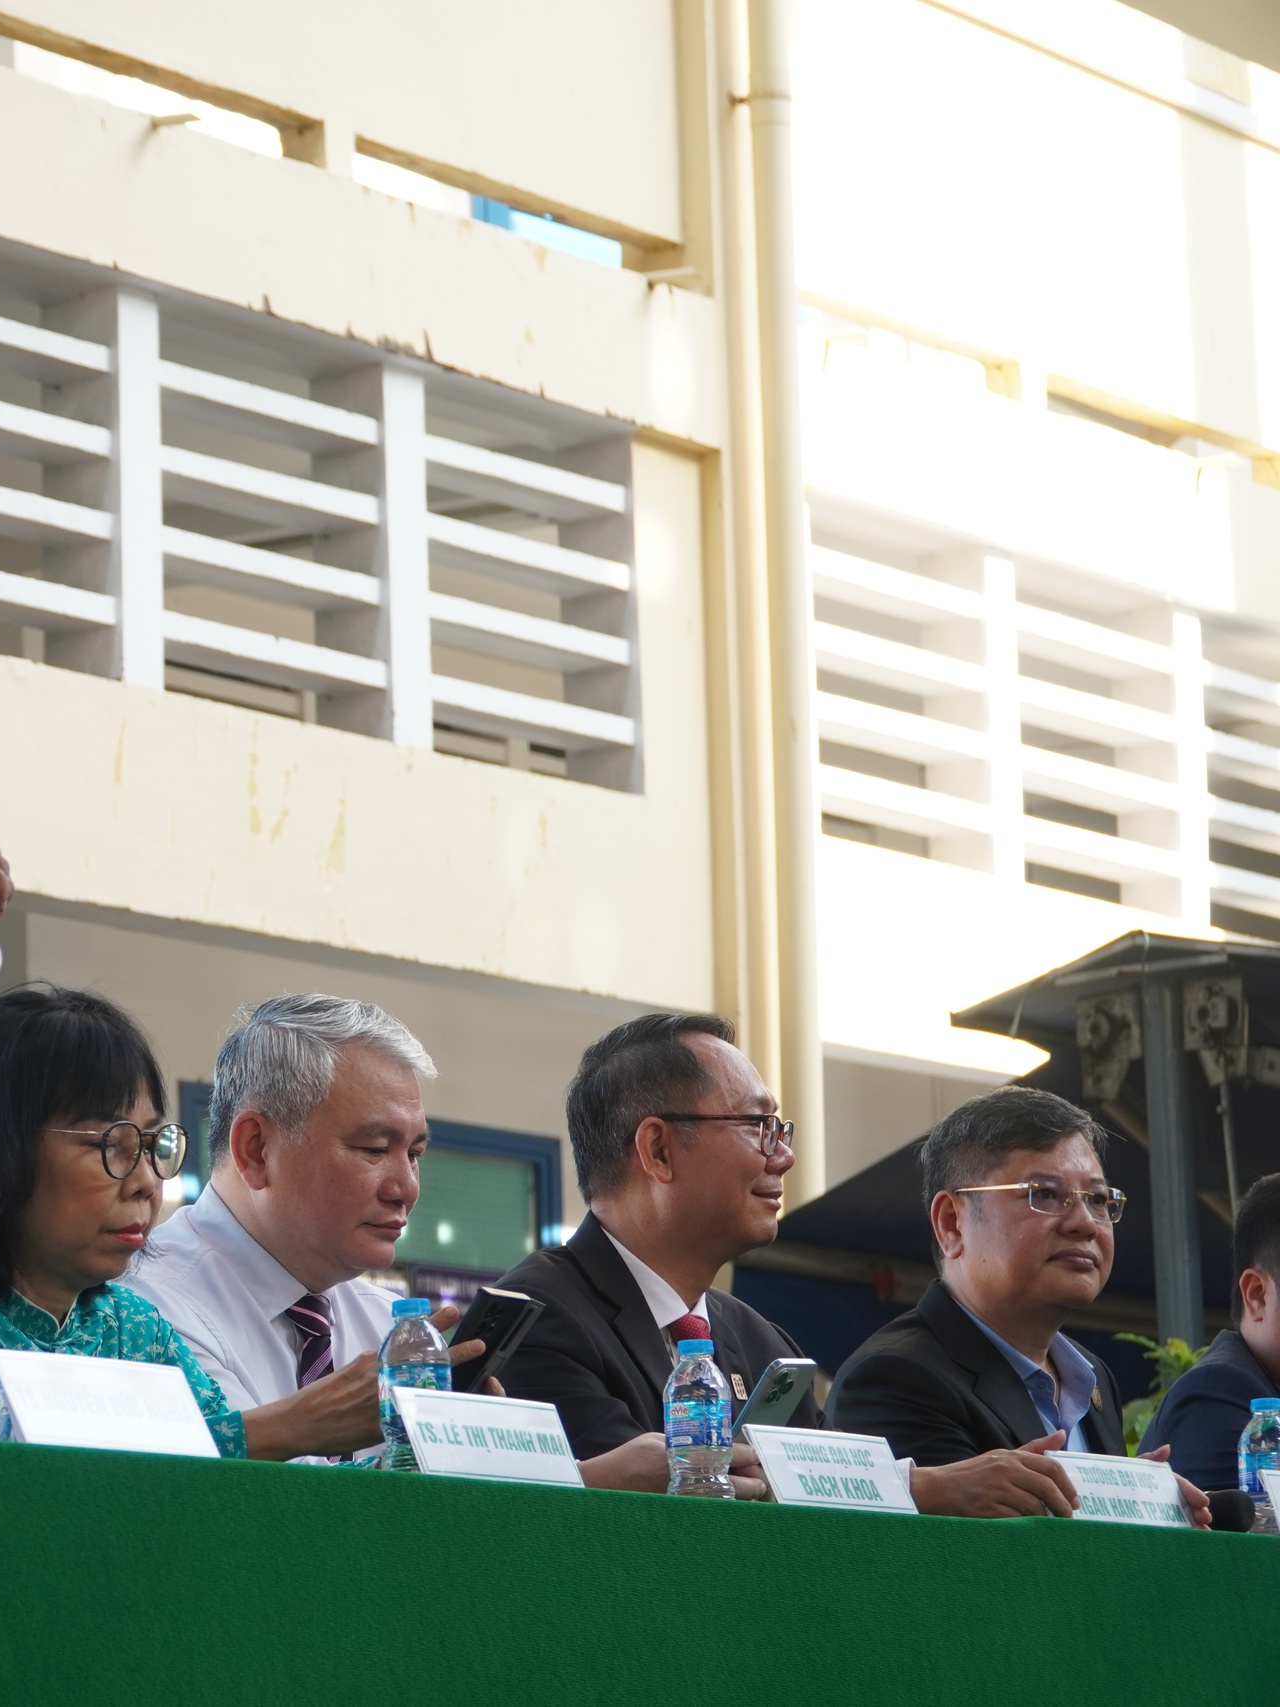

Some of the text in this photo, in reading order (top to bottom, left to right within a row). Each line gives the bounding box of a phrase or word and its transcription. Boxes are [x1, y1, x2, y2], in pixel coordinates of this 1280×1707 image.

[416, 1418, 567, 1457] TS. LÊ THỊ THANH MAI
[780, 1440, 875, 1472] TRƯỜNG ĐẠI HỌC
[797, 1469, 884, 1502] BÁCH KHOA
[1076, 1464, 1159, 1493] TRƯỜNG ĐẠI HỌC
[1078, 1493, 1188, 1523] NGÂN HÀNG TP.HCM
